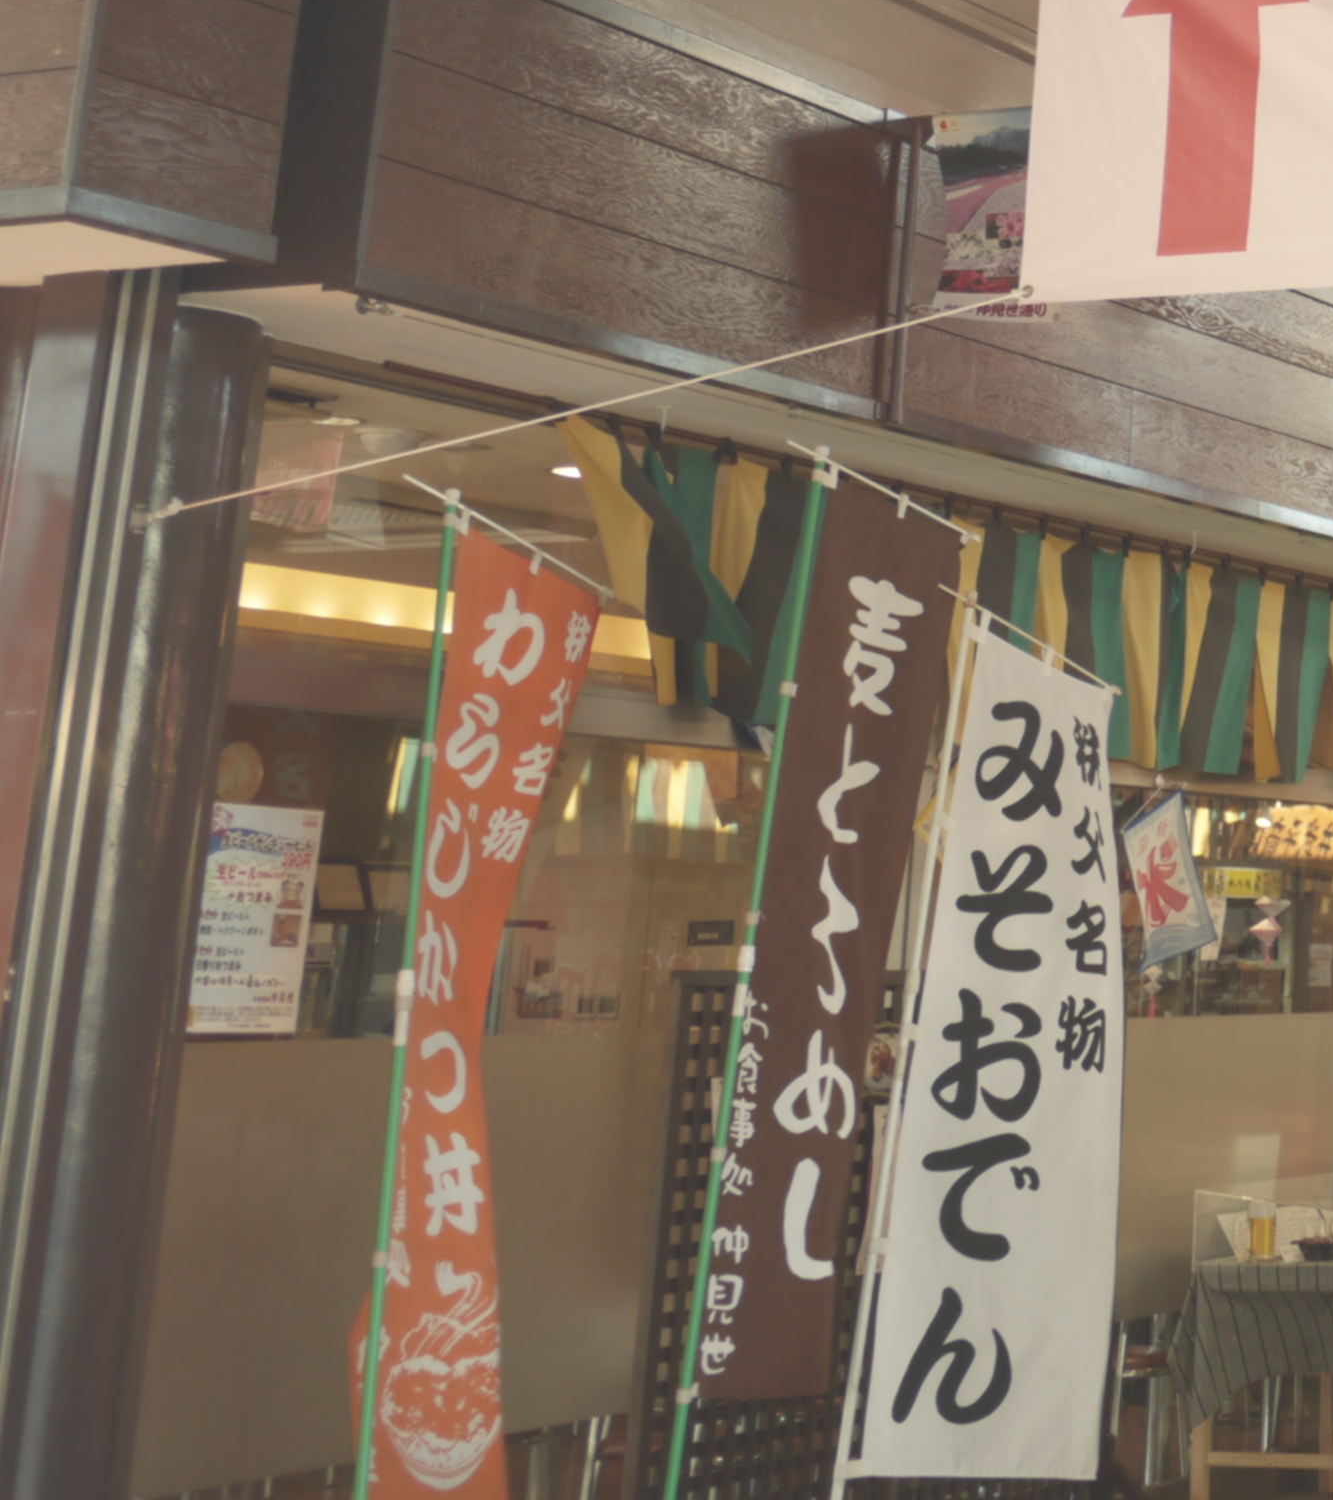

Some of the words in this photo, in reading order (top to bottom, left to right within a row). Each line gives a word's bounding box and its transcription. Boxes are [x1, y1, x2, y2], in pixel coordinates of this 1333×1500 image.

[976, 302, 1048, 318] 仲見世通り
[417, 586, 546, 1237] わらじかつ丼
[481, 609, 592, 864] 秩父名物
[1054, 713, 1110, 1075] 秩父名物
[772, 574, 924, 1282] 麦とろめし
[890, 700, 1067, 1428] みそおでん
[699, 1222, 751, 1377] 仲見世
